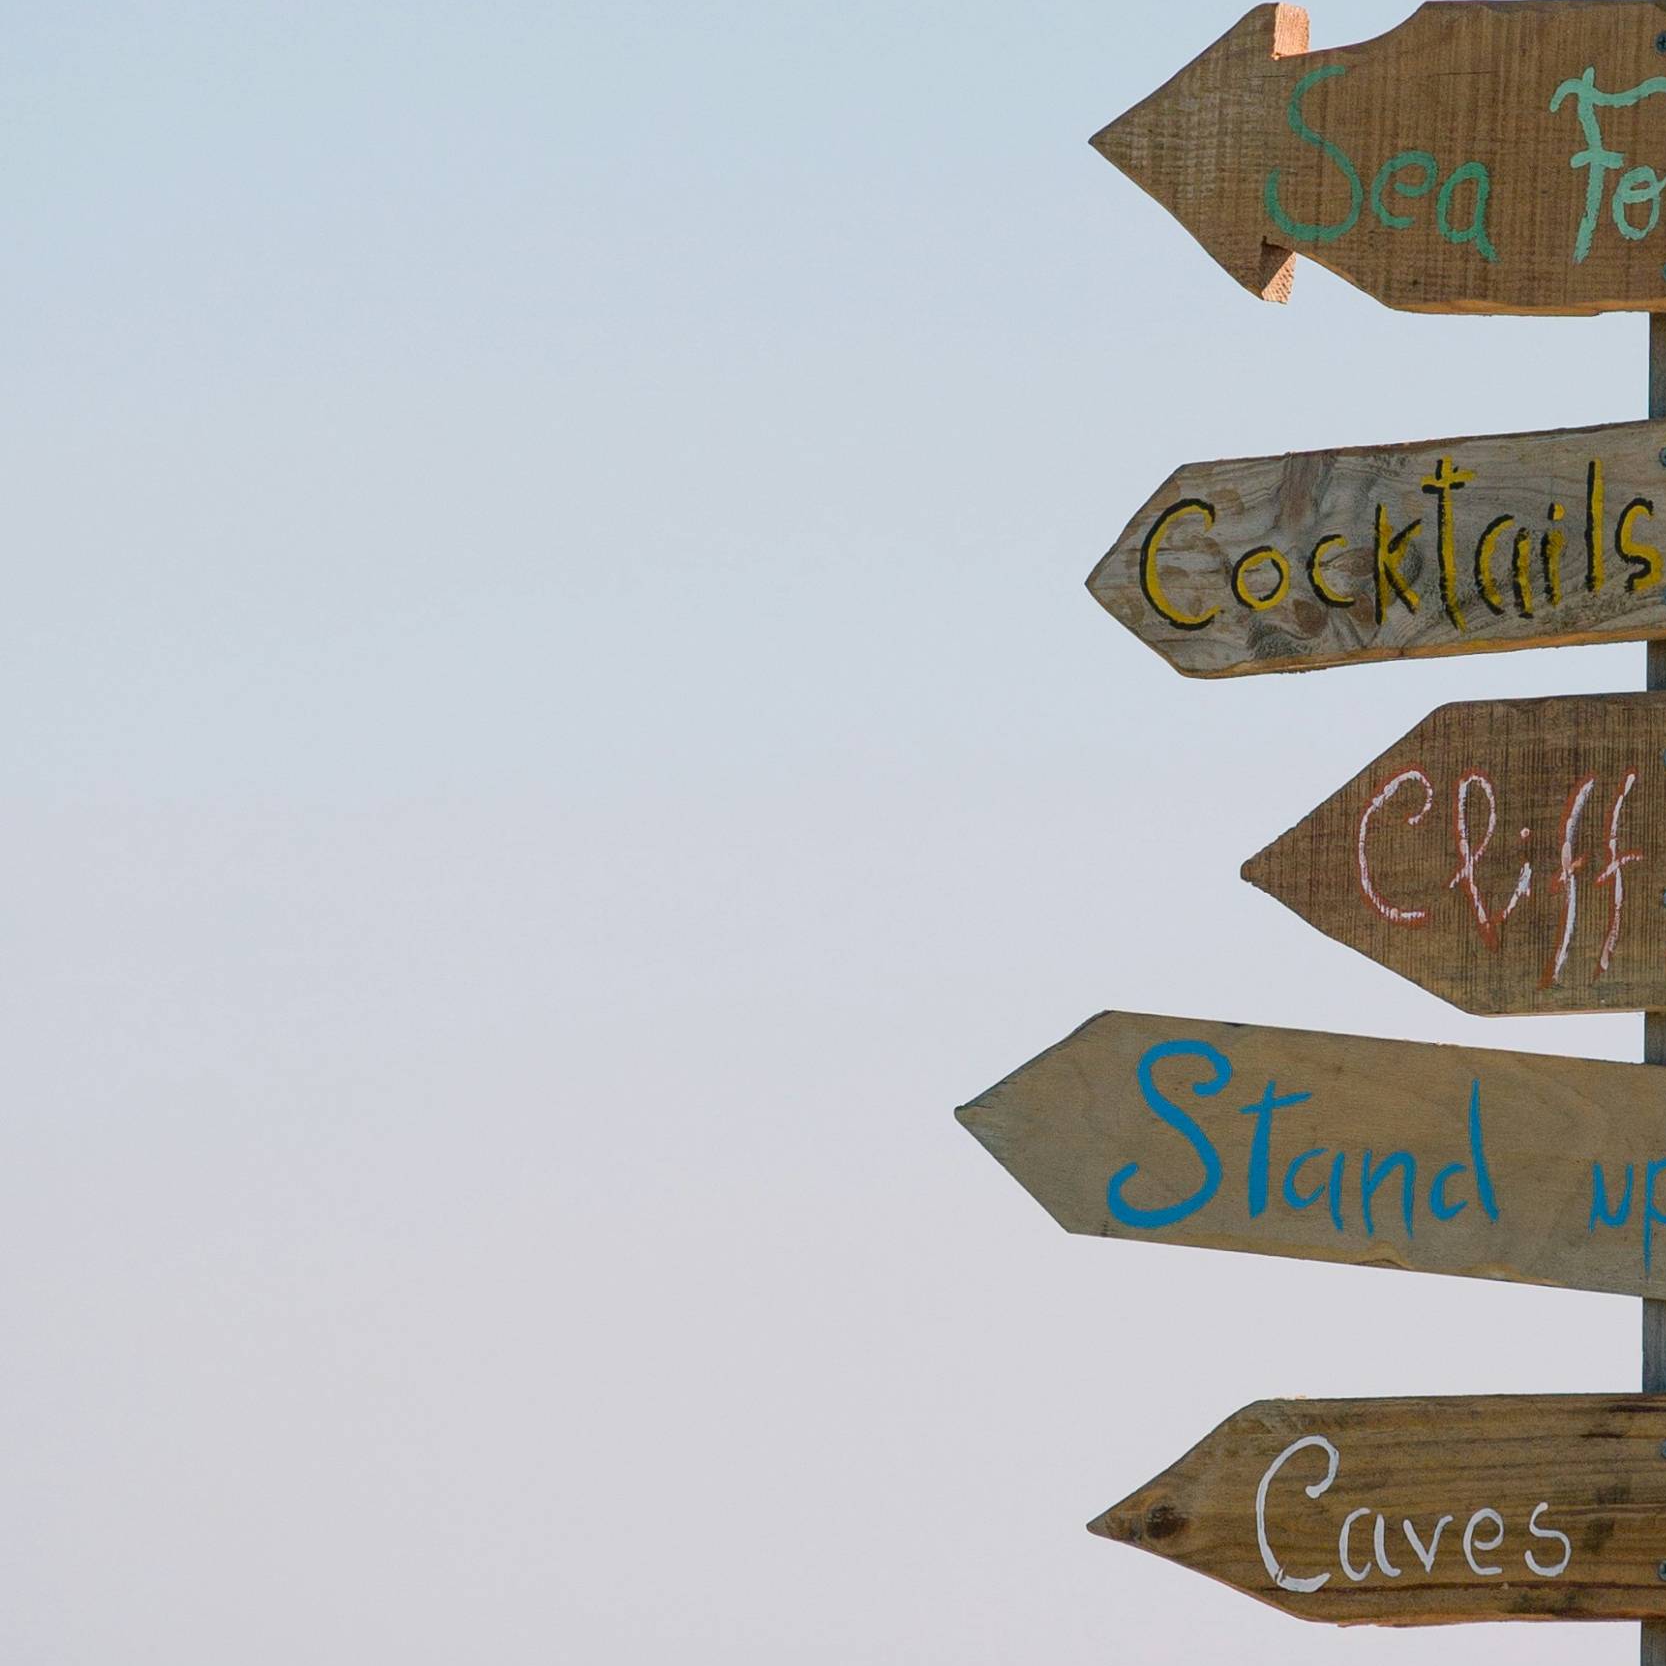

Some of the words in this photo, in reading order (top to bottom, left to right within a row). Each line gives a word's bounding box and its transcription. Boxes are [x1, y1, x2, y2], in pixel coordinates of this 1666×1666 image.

[1264, 65, 1498, 263] Sea
[1139, 454, 1663, 631] Cocktails
[1357, 766, 1643, 989] Cliff
[1108, 1038, 1500, 1230] Stand
[1254, 1434, 1571, 1593] Caves
